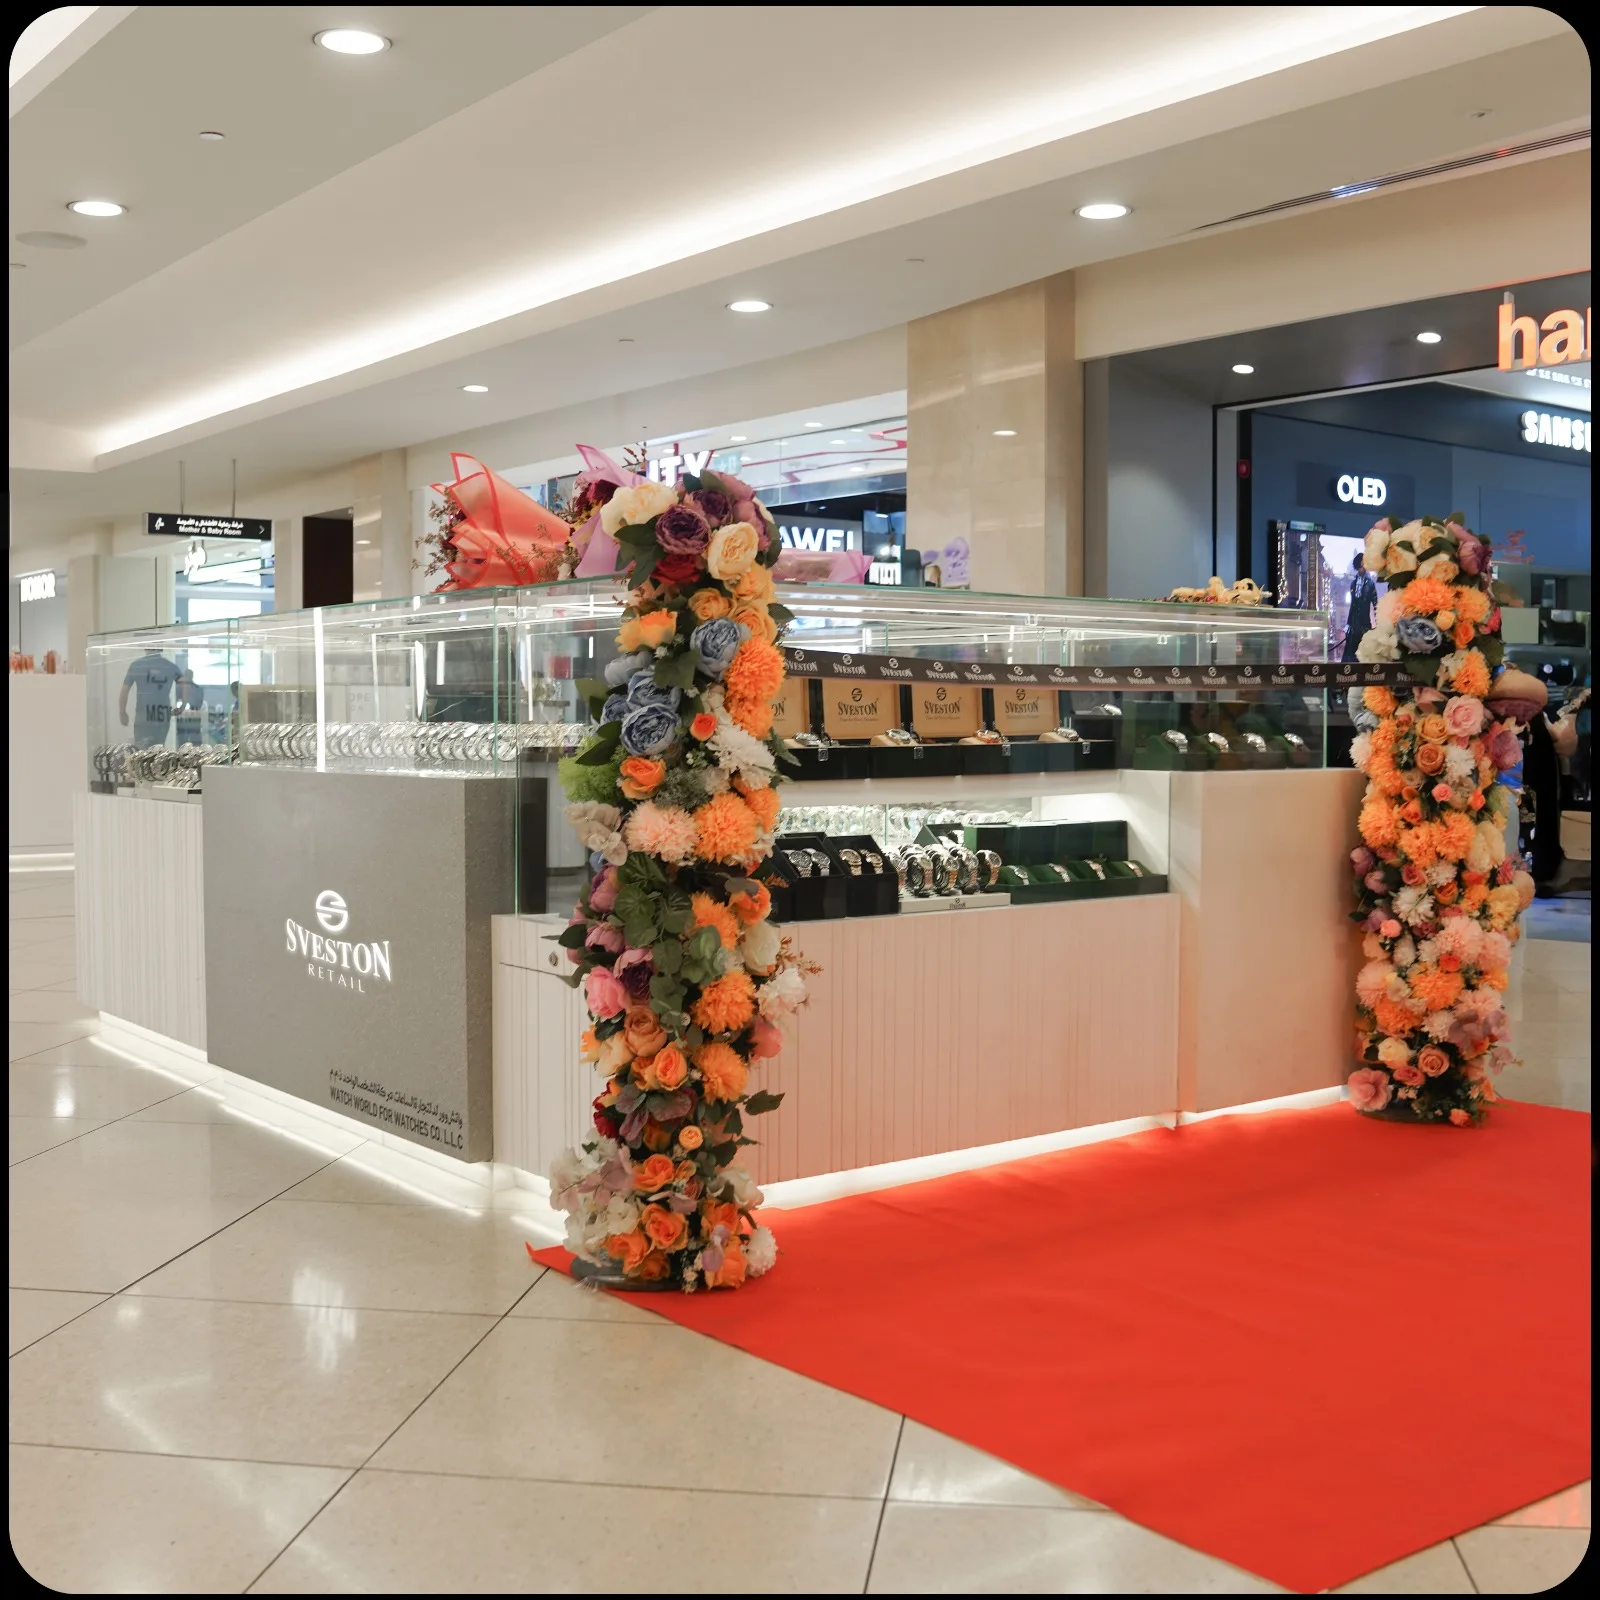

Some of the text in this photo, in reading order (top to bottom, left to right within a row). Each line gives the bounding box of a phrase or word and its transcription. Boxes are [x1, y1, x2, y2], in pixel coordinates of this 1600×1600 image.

[1337, 474, 1386, 506] OLED
[179, 525, 200, 533] Mother
[207, 526, 223, 535] Baby
[224, 527, 241, 535] Room
[832, 662, 867, 675] SVESTON
[880, 666, 914, 678] SVESTON
[837, 701, 878, 716] SVESTON
[924, 700, 960, 714] SVESTON
[1004, 700, 1039, 714] SVESTON
[286, 918, 391, 982] SVESTON
[308, 963, 366, 993] RETAIL
[329, 1086, 352, 1108] WATCH
[353, 1094, 378, 1118] WORLD
[379, 1105, 393, 1123] FOR
[393, 1111, 429, 1138] WATCHES
